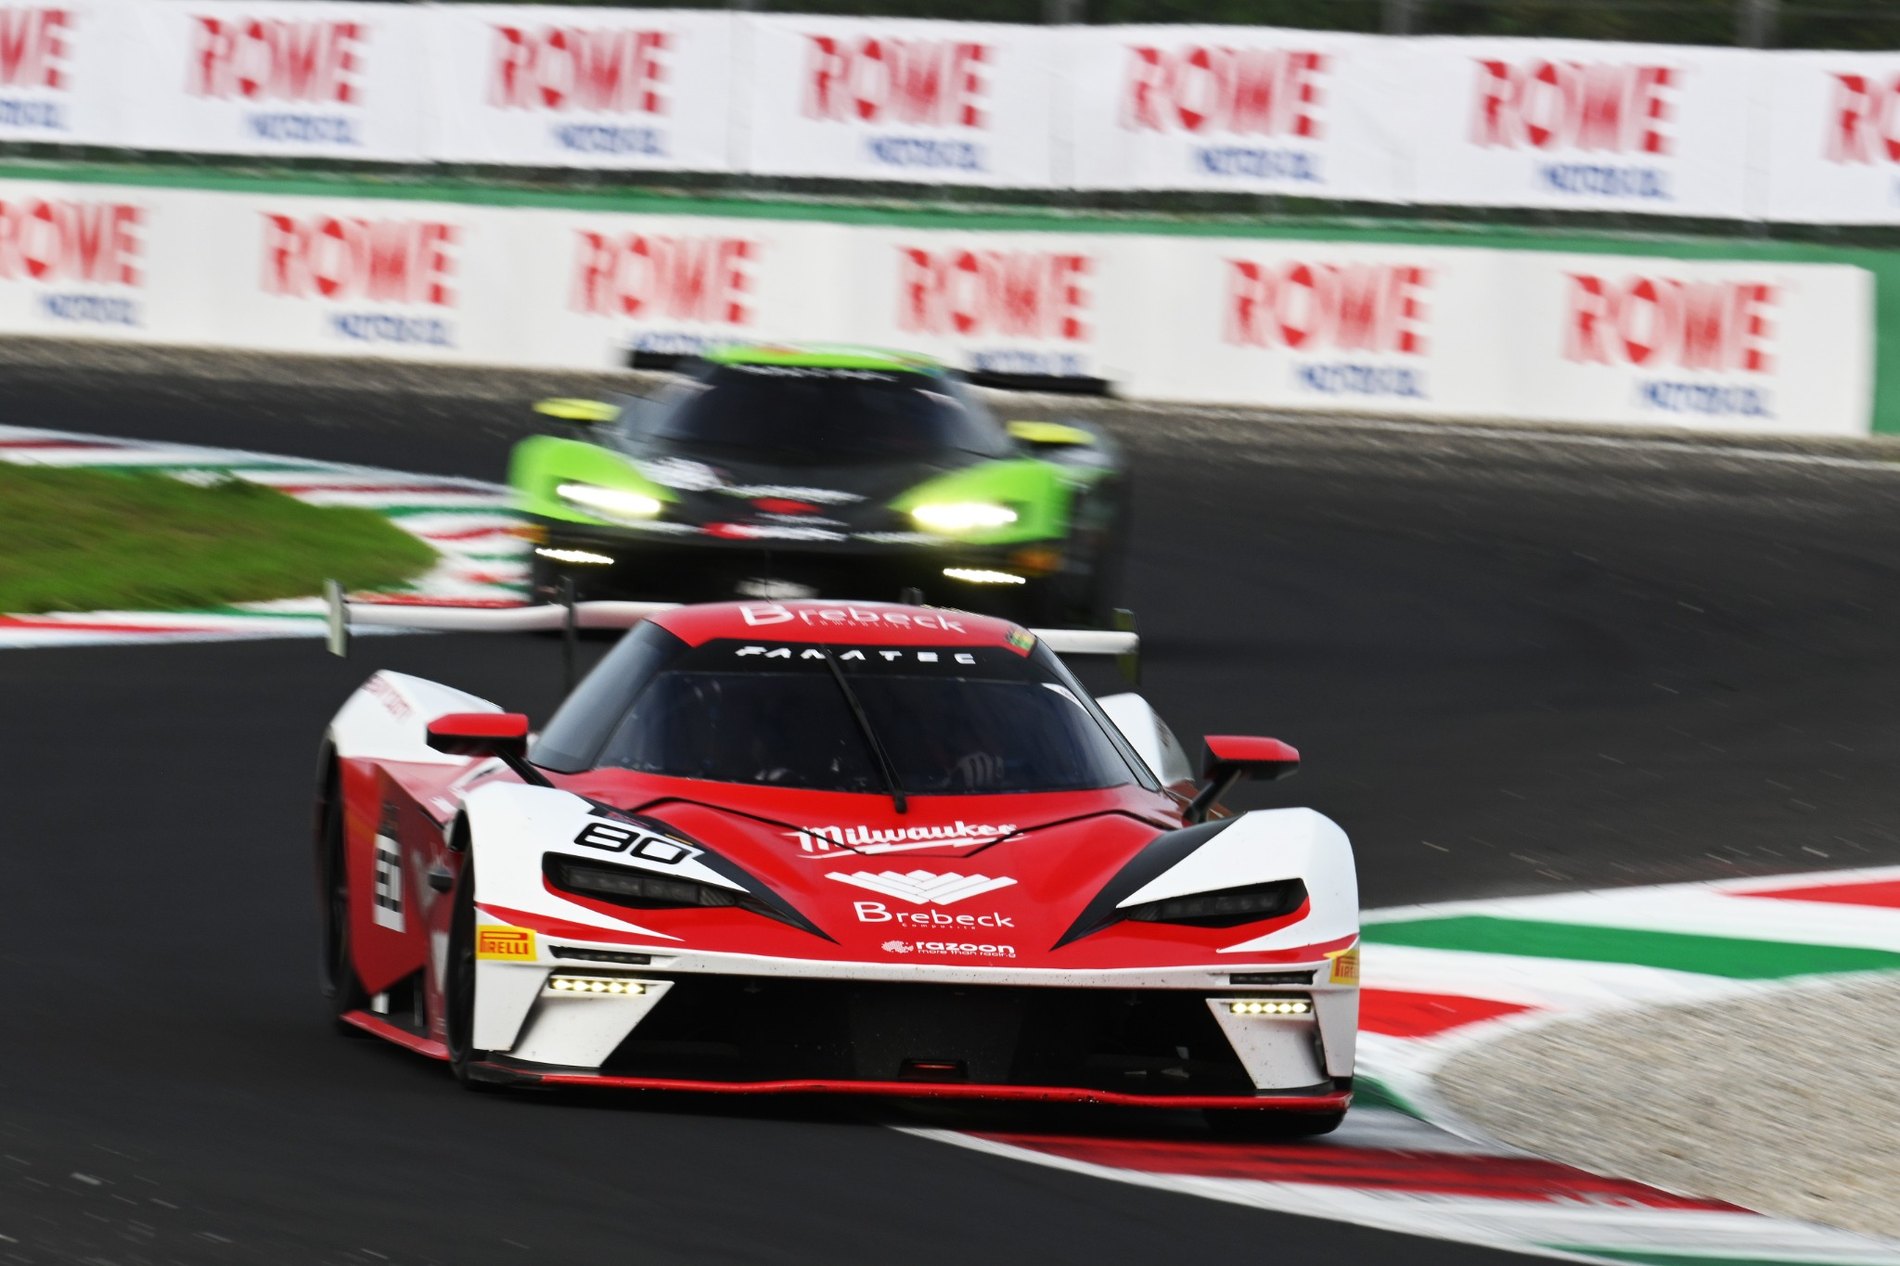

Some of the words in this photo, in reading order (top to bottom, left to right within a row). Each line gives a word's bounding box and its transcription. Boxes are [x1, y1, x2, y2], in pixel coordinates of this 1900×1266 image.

[190, 15, 368, 104] ROWE
[490, 25, 674, 114] ROWE
[802, 33, 993, 128] ROWE
[1123, 44, 1331, 139] ROWE
[1470, 58, 1680, 155] ROWE
[261, 211, 463, 307] ROWE
[570, 229, 762, 325] ROWE
[896, 245, 1097, 342] ROWE
[1221, 257, 1436, 356] ROWE
[1560, 270, 1783, 374] ROWE
[735, 646, 976, 665] FANATEC
[739, 601, 967, 634] Brebeck
[573, 822, 693, 865] 80
[479, 931, 529, 955] PIRELLI
[853, 901, 1015, 928] Brebeck
[915, 941, 1015, 954] razoon
